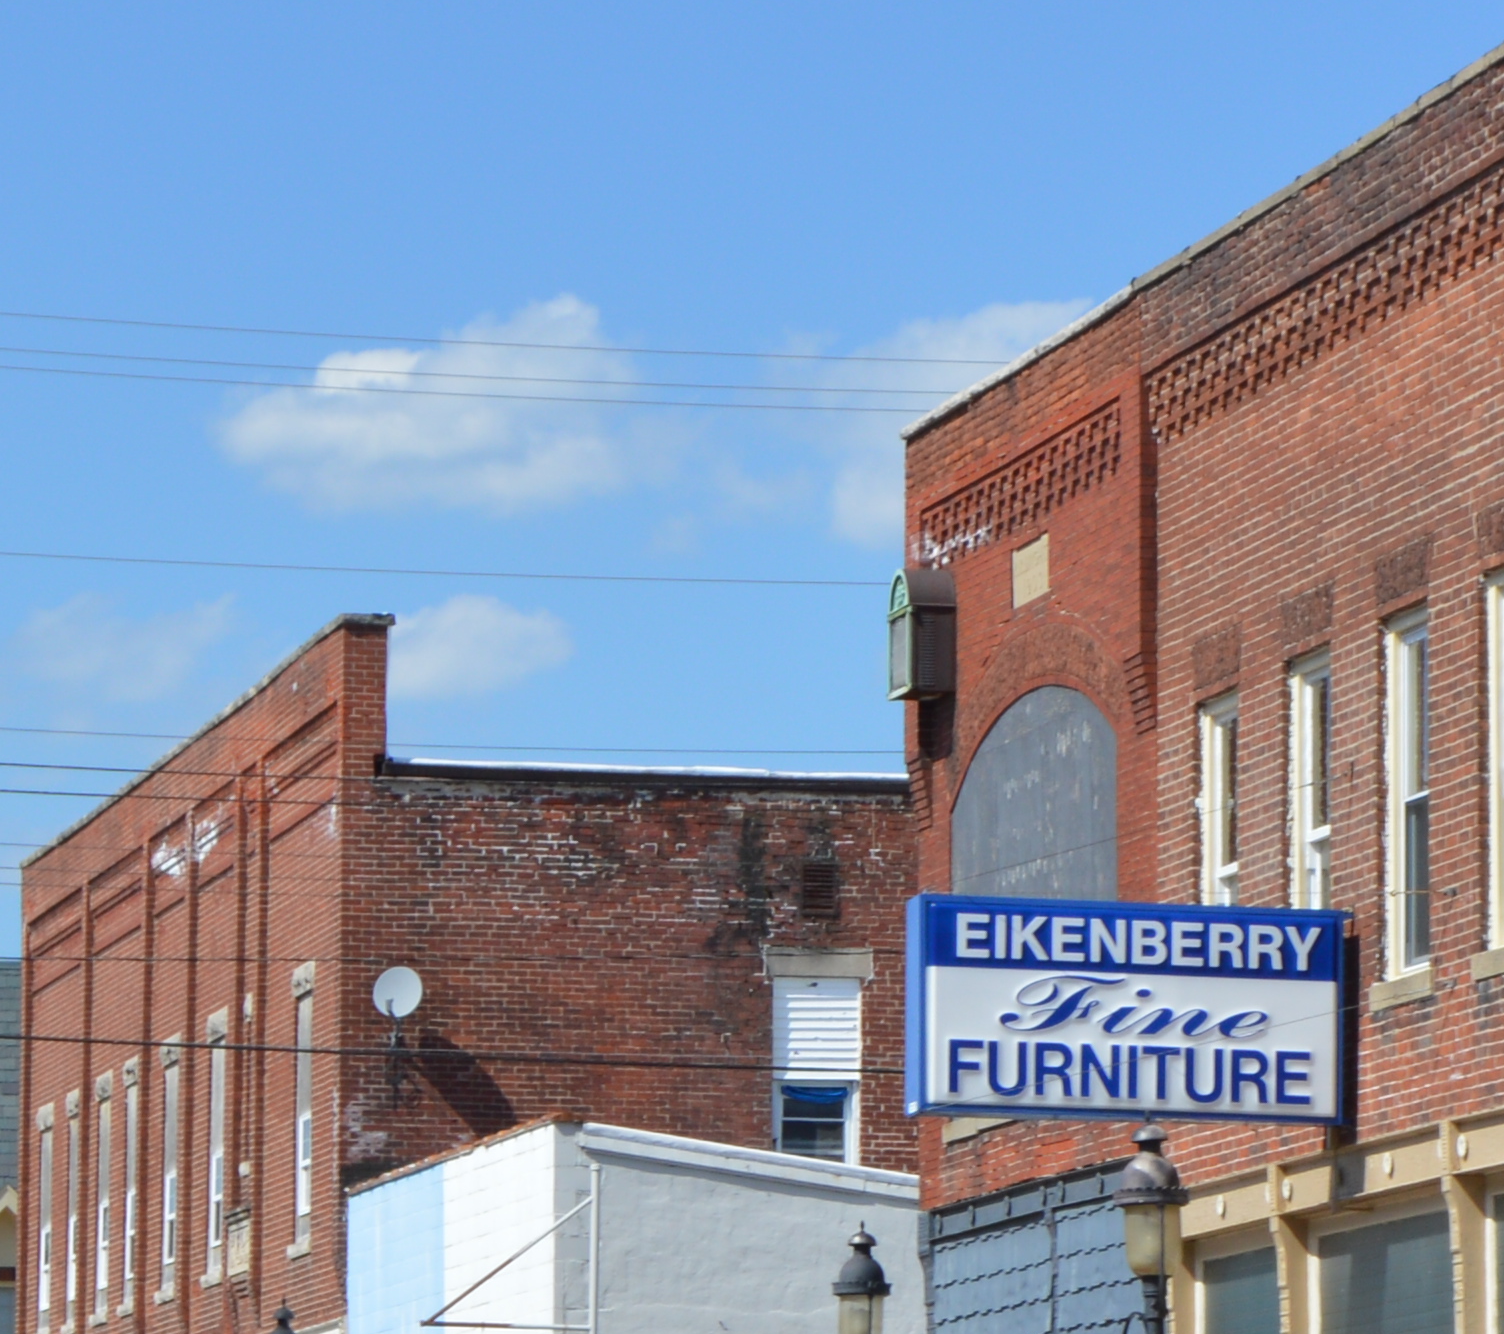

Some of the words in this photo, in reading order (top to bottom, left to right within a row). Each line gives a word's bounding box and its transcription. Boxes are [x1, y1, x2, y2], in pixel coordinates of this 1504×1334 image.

[955, 912, 1322, 973] EIKENBERRY
[998, 974, 1270, 1039] Fine
[948, 1038, 1312, 1106] FURNITURE
